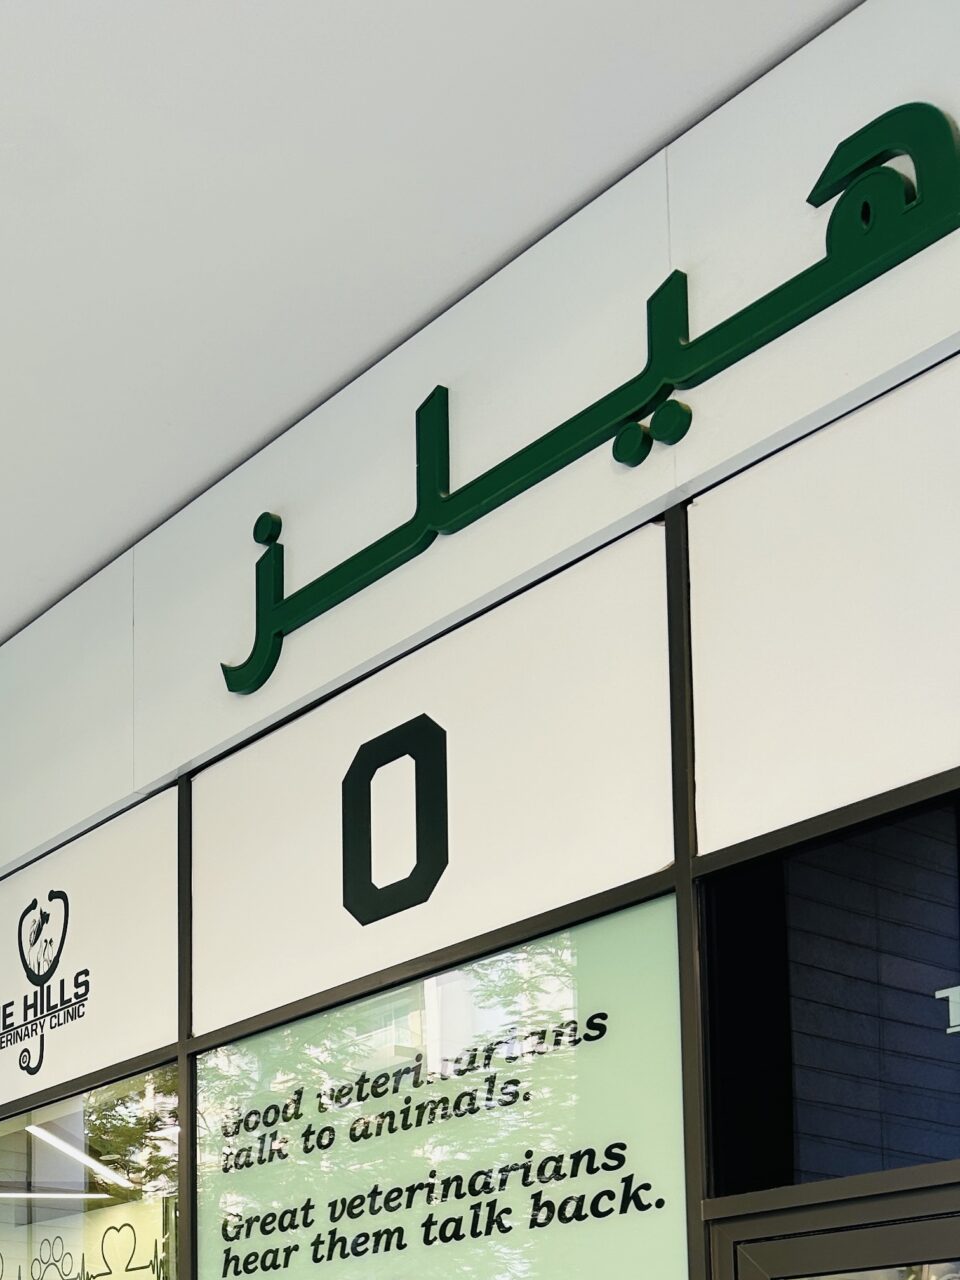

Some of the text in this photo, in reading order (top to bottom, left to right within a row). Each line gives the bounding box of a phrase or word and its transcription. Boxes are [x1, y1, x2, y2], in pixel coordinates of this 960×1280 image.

[220, 101, 960, 694] هيلز
[23, 968, 90, 1022] HILLS
[49, 1003, 86, 1030] CLINIC
[317, 1011, 609, 1114] veteriarans
[221, 1072, 534, 1174] talk to animals.
[221, 1141, 628, 1242] Great veterinarians
[221, 1173, 667, 1279] hear them talk back.
